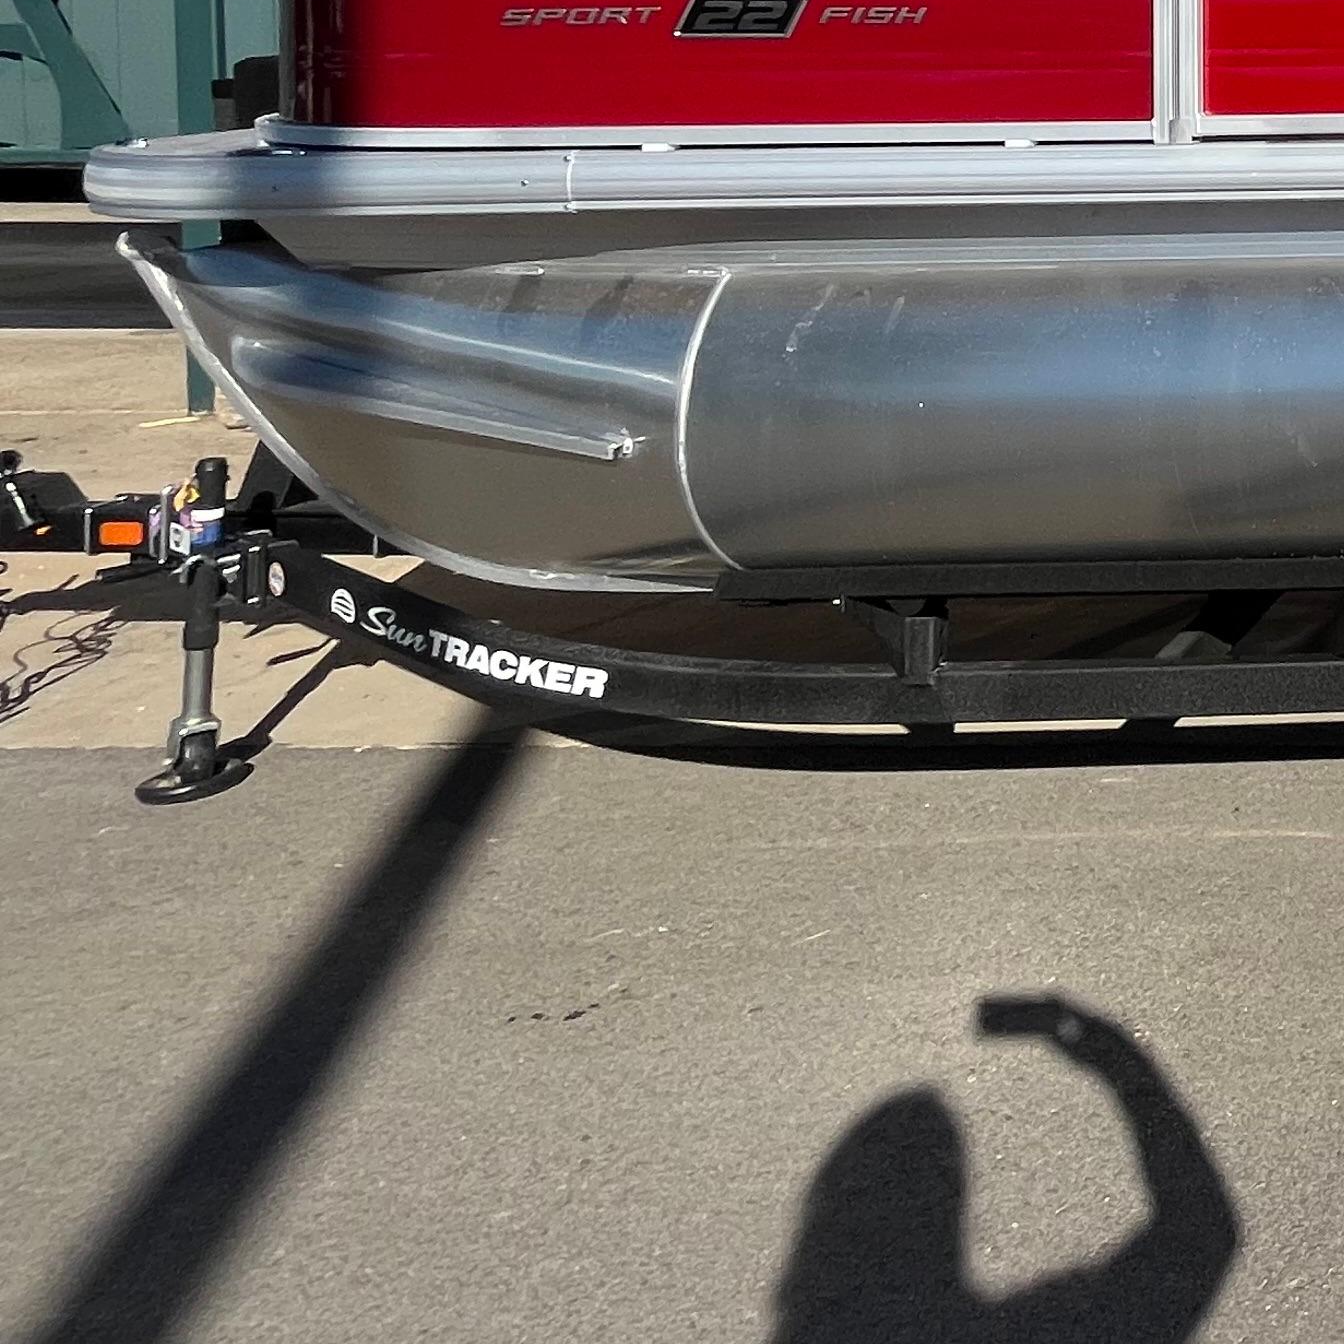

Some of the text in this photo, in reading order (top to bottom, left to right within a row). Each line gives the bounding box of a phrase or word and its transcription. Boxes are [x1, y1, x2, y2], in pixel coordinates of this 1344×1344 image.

[499, 0, 929, 31] SPORT 22 FISH
[359, 606, 609, 699] Sun TRACKER
